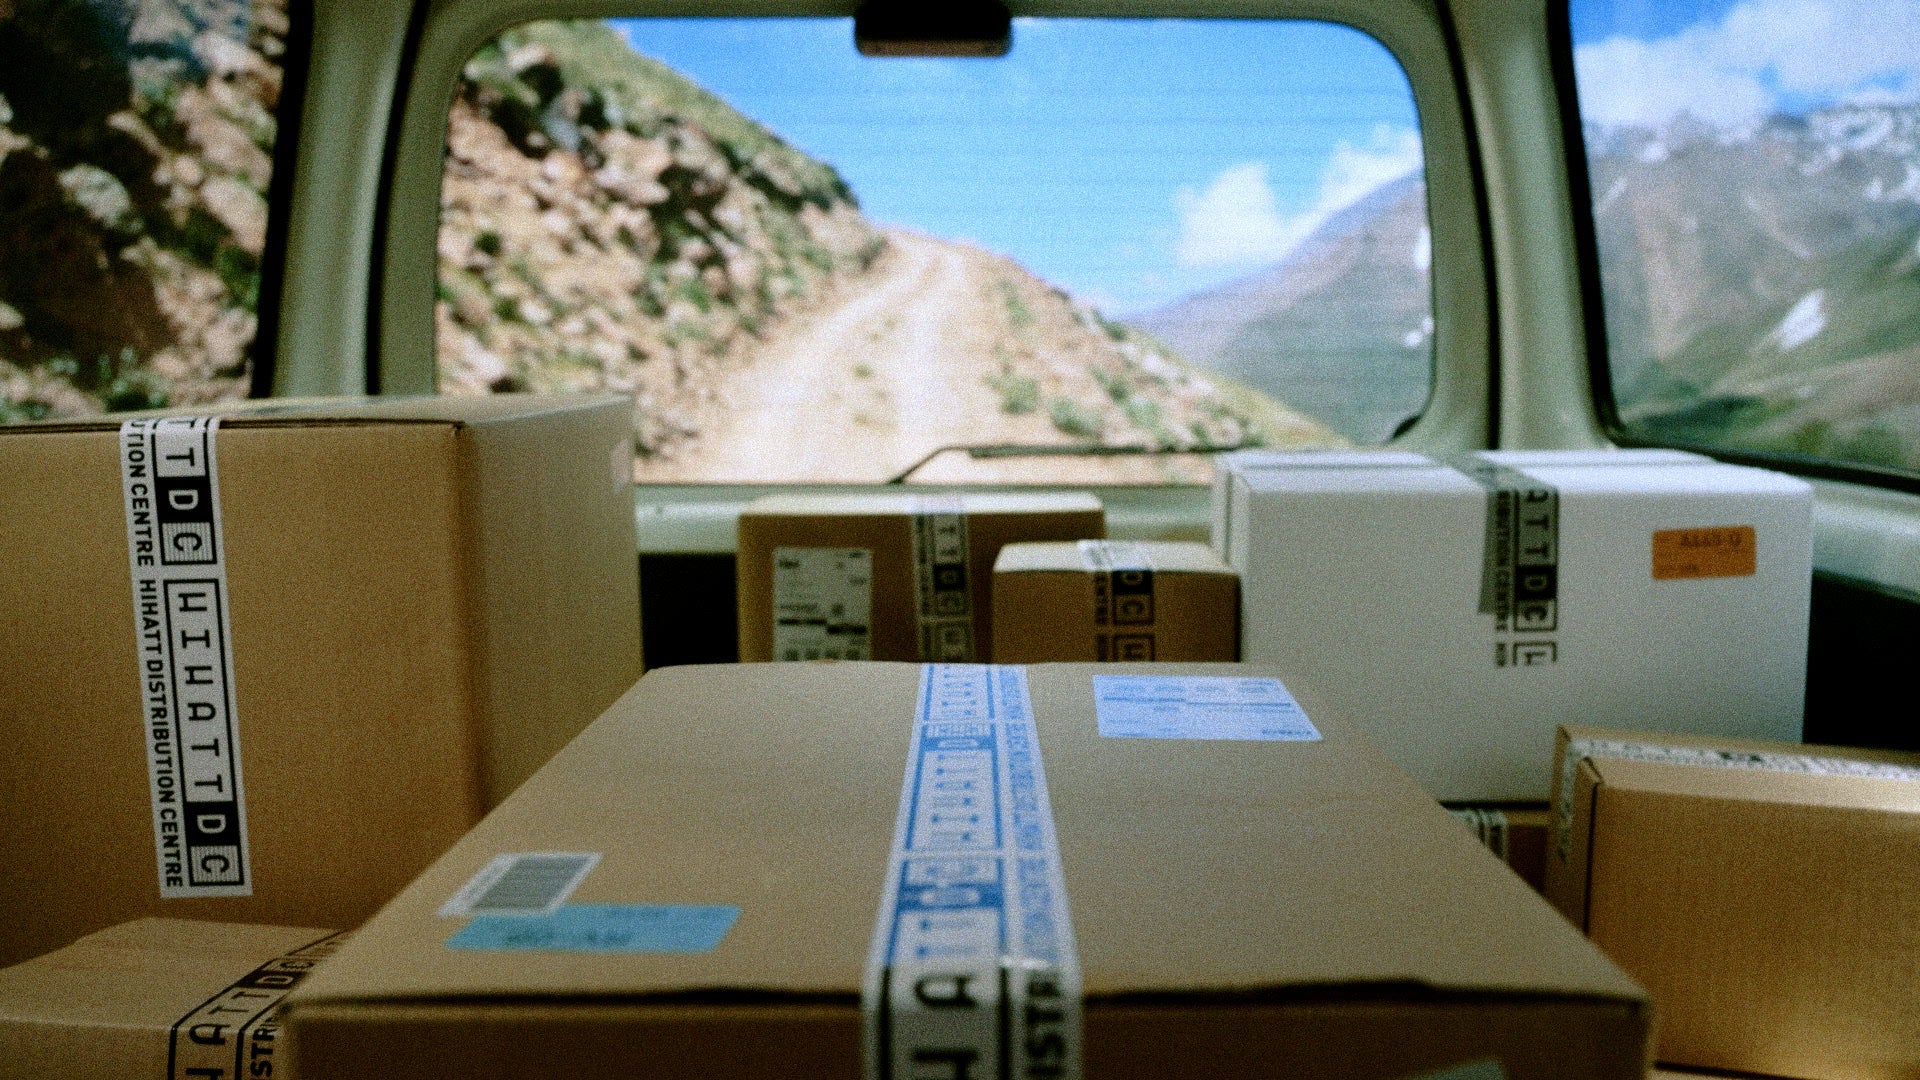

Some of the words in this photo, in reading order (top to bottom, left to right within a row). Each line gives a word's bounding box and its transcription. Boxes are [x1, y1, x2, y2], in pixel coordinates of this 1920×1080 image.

[131, 483, 155, 567] CENTRE
[139, 579, 162, 654] HIHATT
[146, 659, 175, 803] DISTRIBUTION
[160, 808, 183, 887] CENTRE
